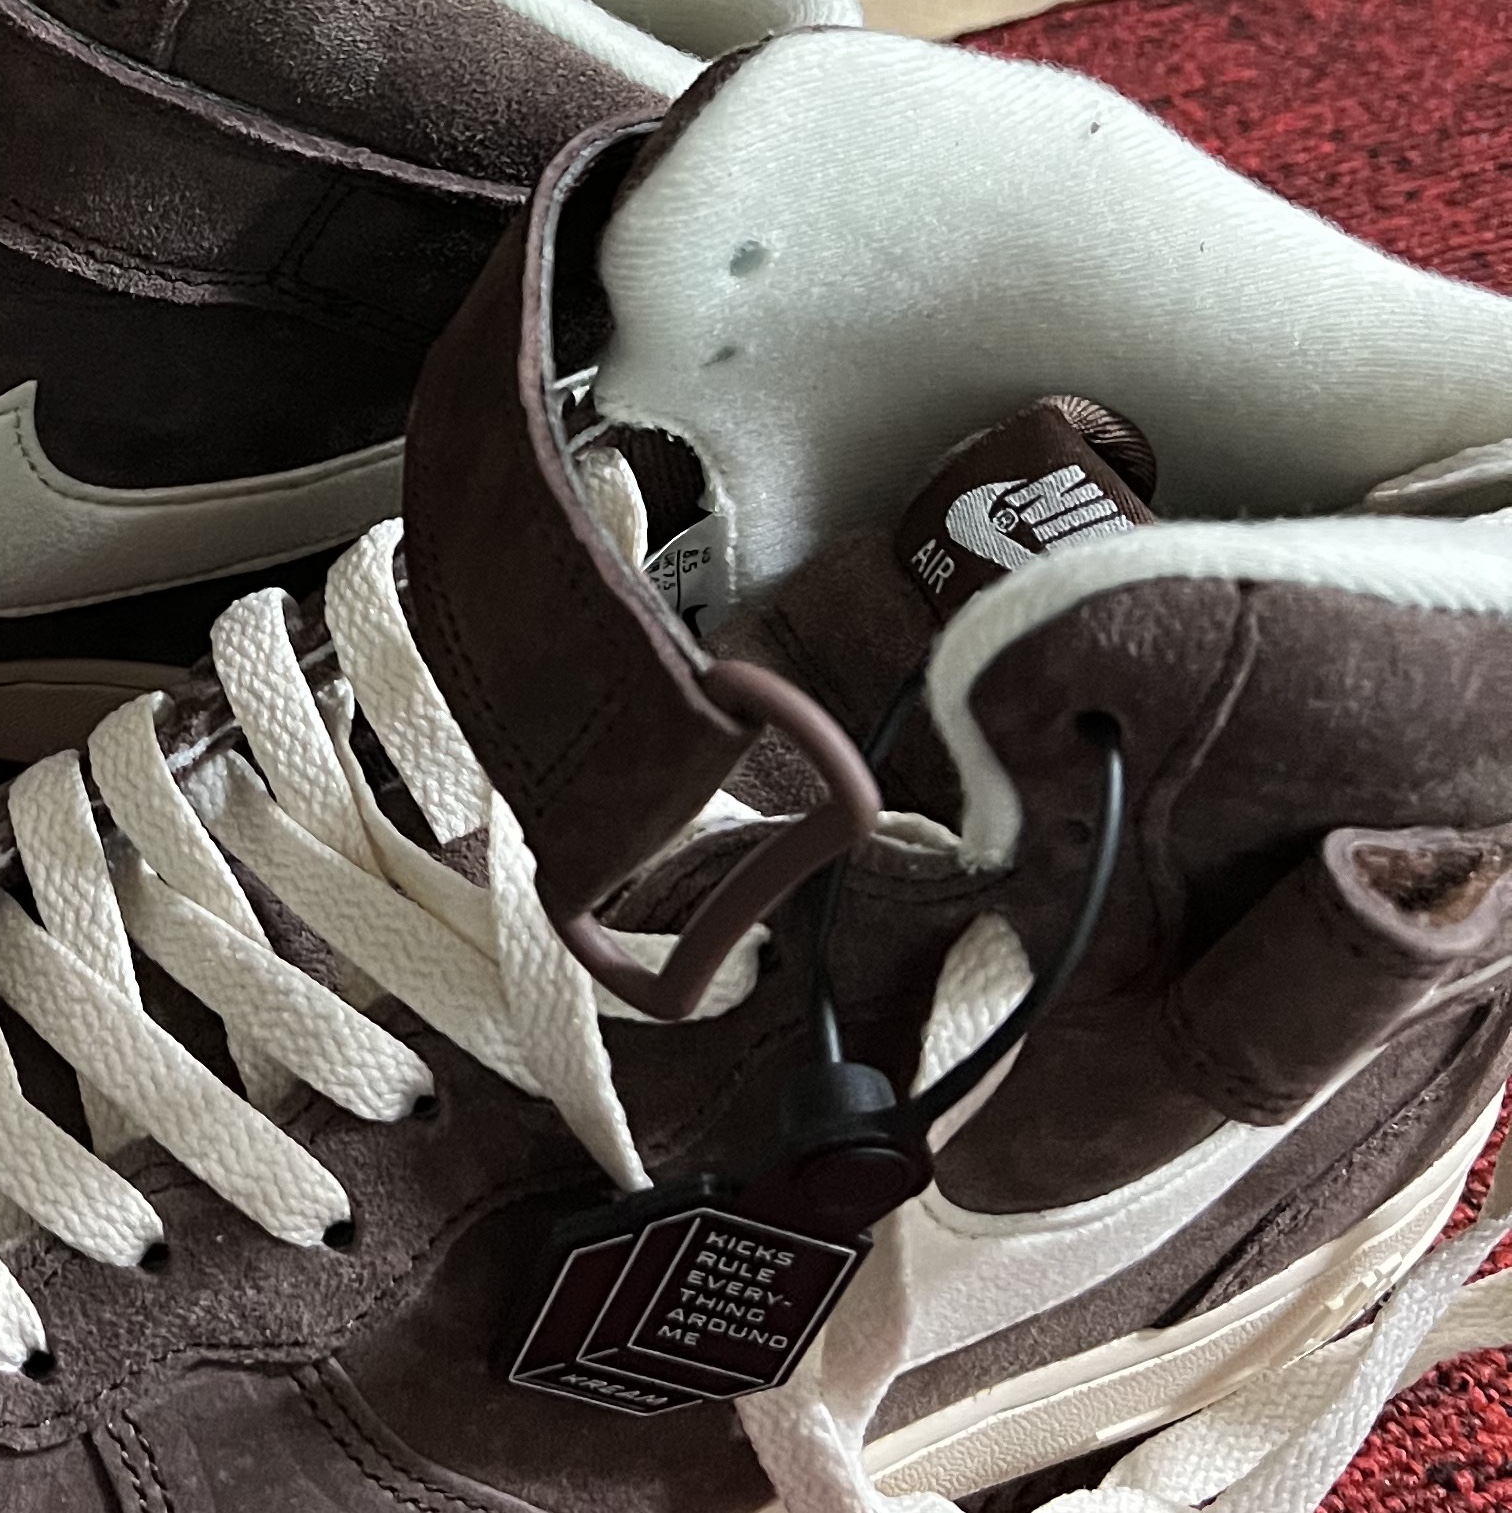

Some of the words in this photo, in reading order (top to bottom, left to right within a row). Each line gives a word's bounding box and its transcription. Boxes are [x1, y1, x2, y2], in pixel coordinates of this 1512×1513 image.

[911, 538, 956, 594] AIR
[696, 1250, 776, 1284] RULE
[705, 1231, 795, 1267] KICKS
[679, 1287, 765, 1323] THING
[657, 1324, 701, 1346] ME
[666, 1307, 789, 1350] AROUND
